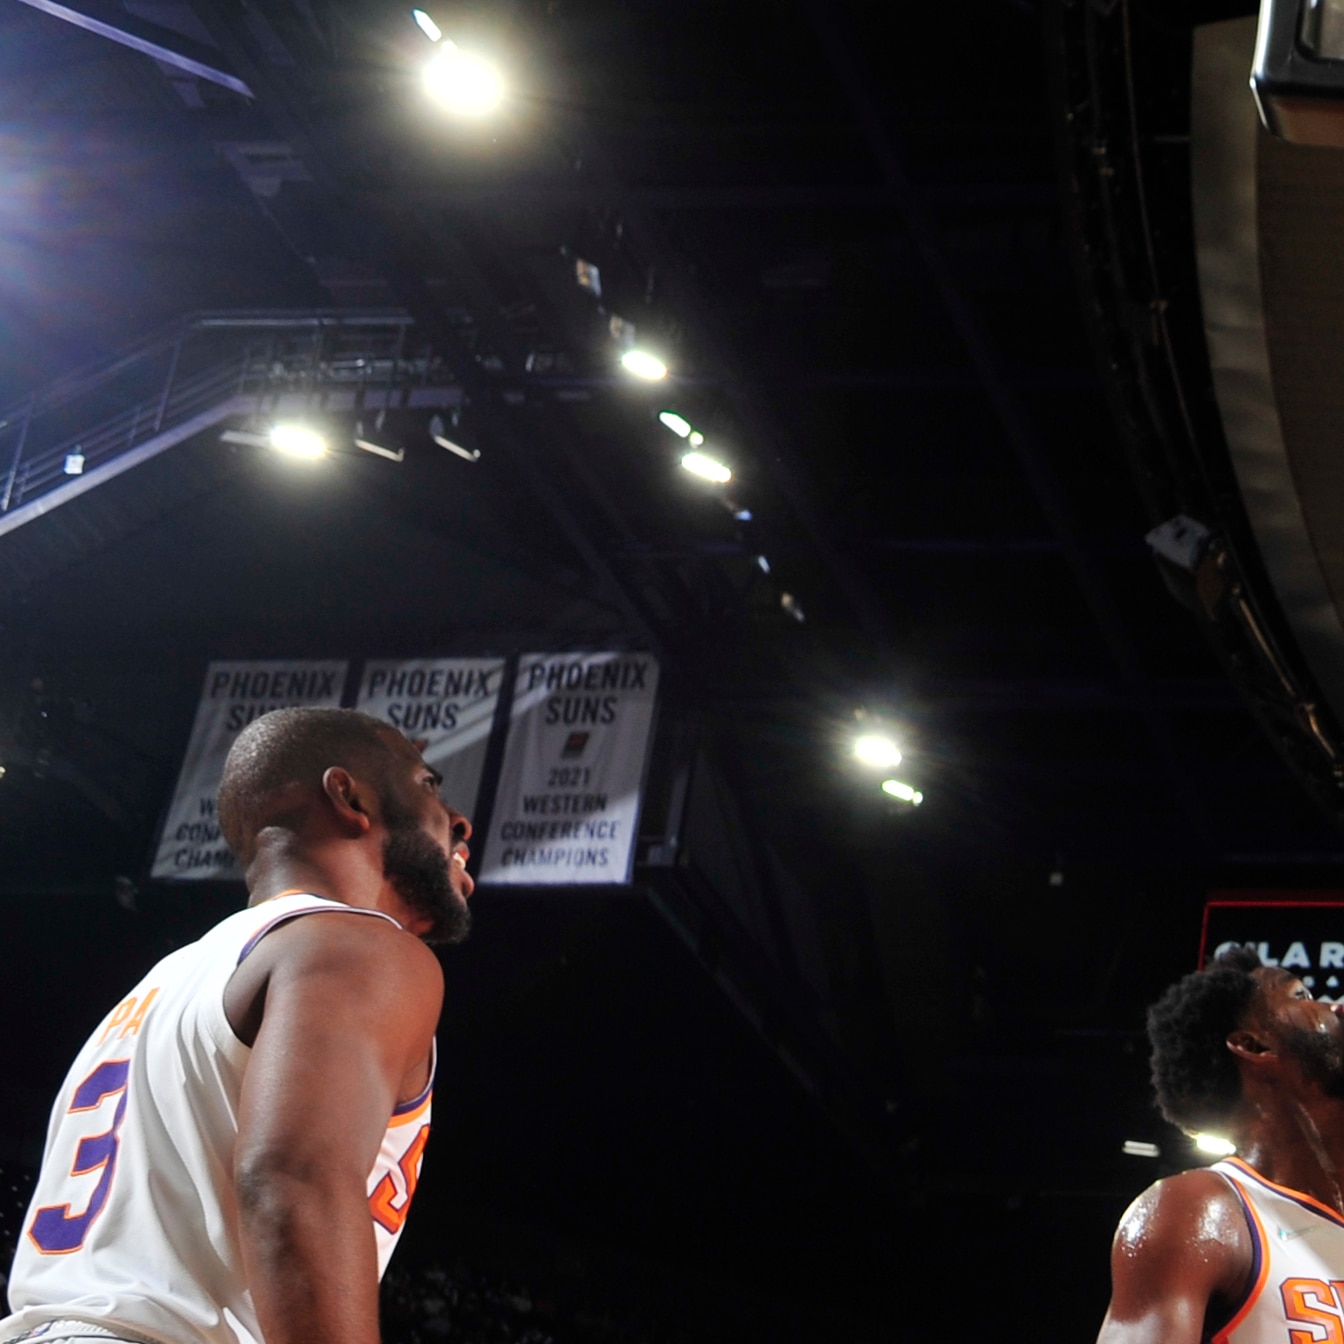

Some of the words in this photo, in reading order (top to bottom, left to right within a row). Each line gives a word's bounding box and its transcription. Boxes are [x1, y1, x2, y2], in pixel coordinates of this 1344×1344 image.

[211, 670, 336, 698] PHOENIX
[368, 668, 491, 698] PHOENIX
[528, 661, 647, 691] PHOENIX
[388, 703, 457, 730] SUNS
[545, 697, 617, 725] SUNS
[547, 768, 591, 788] 2021
[523, 794, 608, 814] WESTERN
[500, 821, 621, 841] CONFERENCE
[500, 847, 609, 867] CHAMPIONS
[27, 1058, 131, 1255] 3
